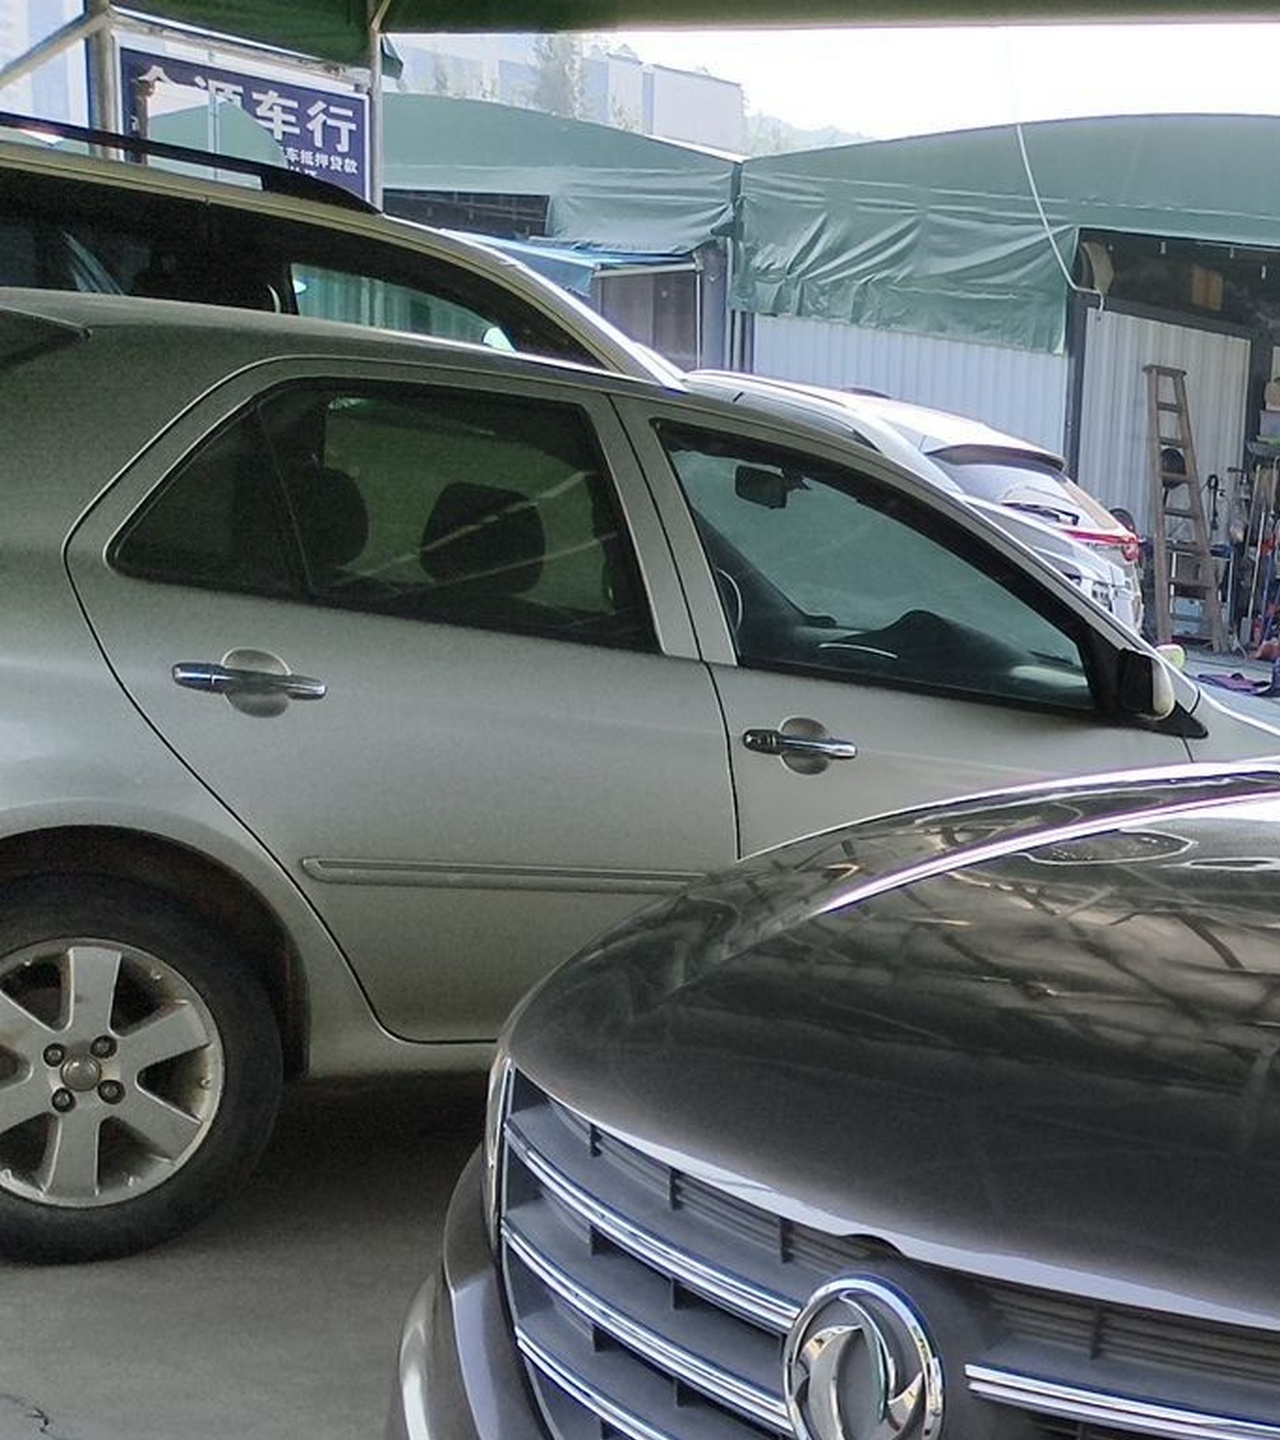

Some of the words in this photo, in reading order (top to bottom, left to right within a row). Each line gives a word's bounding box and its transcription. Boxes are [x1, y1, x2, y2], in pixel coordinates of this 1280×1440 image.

[279, 147, 358, 174] 车抵押贷款
